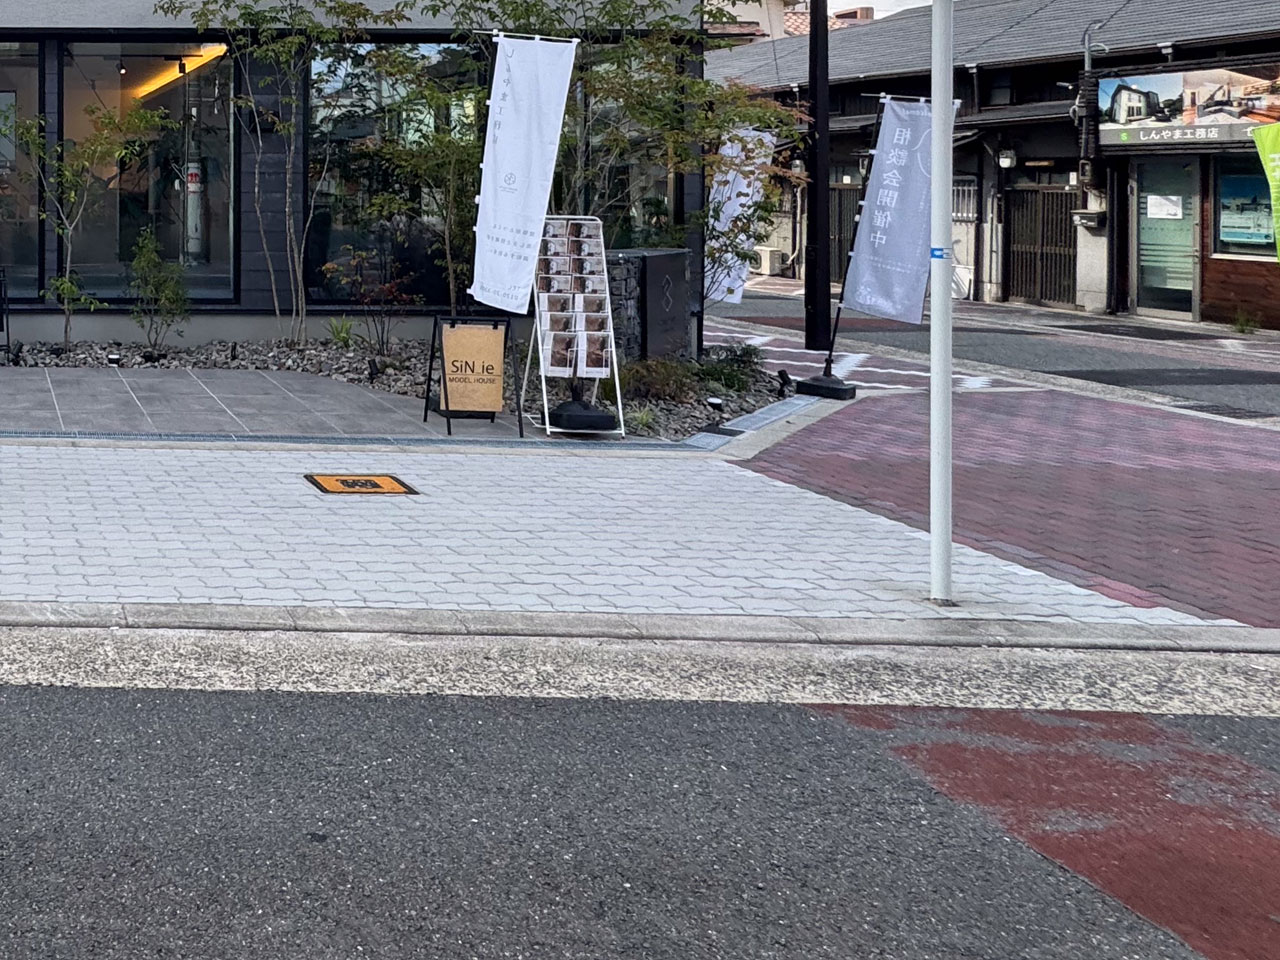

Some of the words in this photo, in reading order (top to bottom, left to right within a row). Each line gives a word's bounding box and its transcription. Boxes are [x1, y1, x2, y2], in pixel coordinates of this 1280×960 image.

[1139, 127, 1219, 141] しんやま工務店
[448, 376, 472, 384] MODEL
[474, 377, 497, 385] HOUSE
